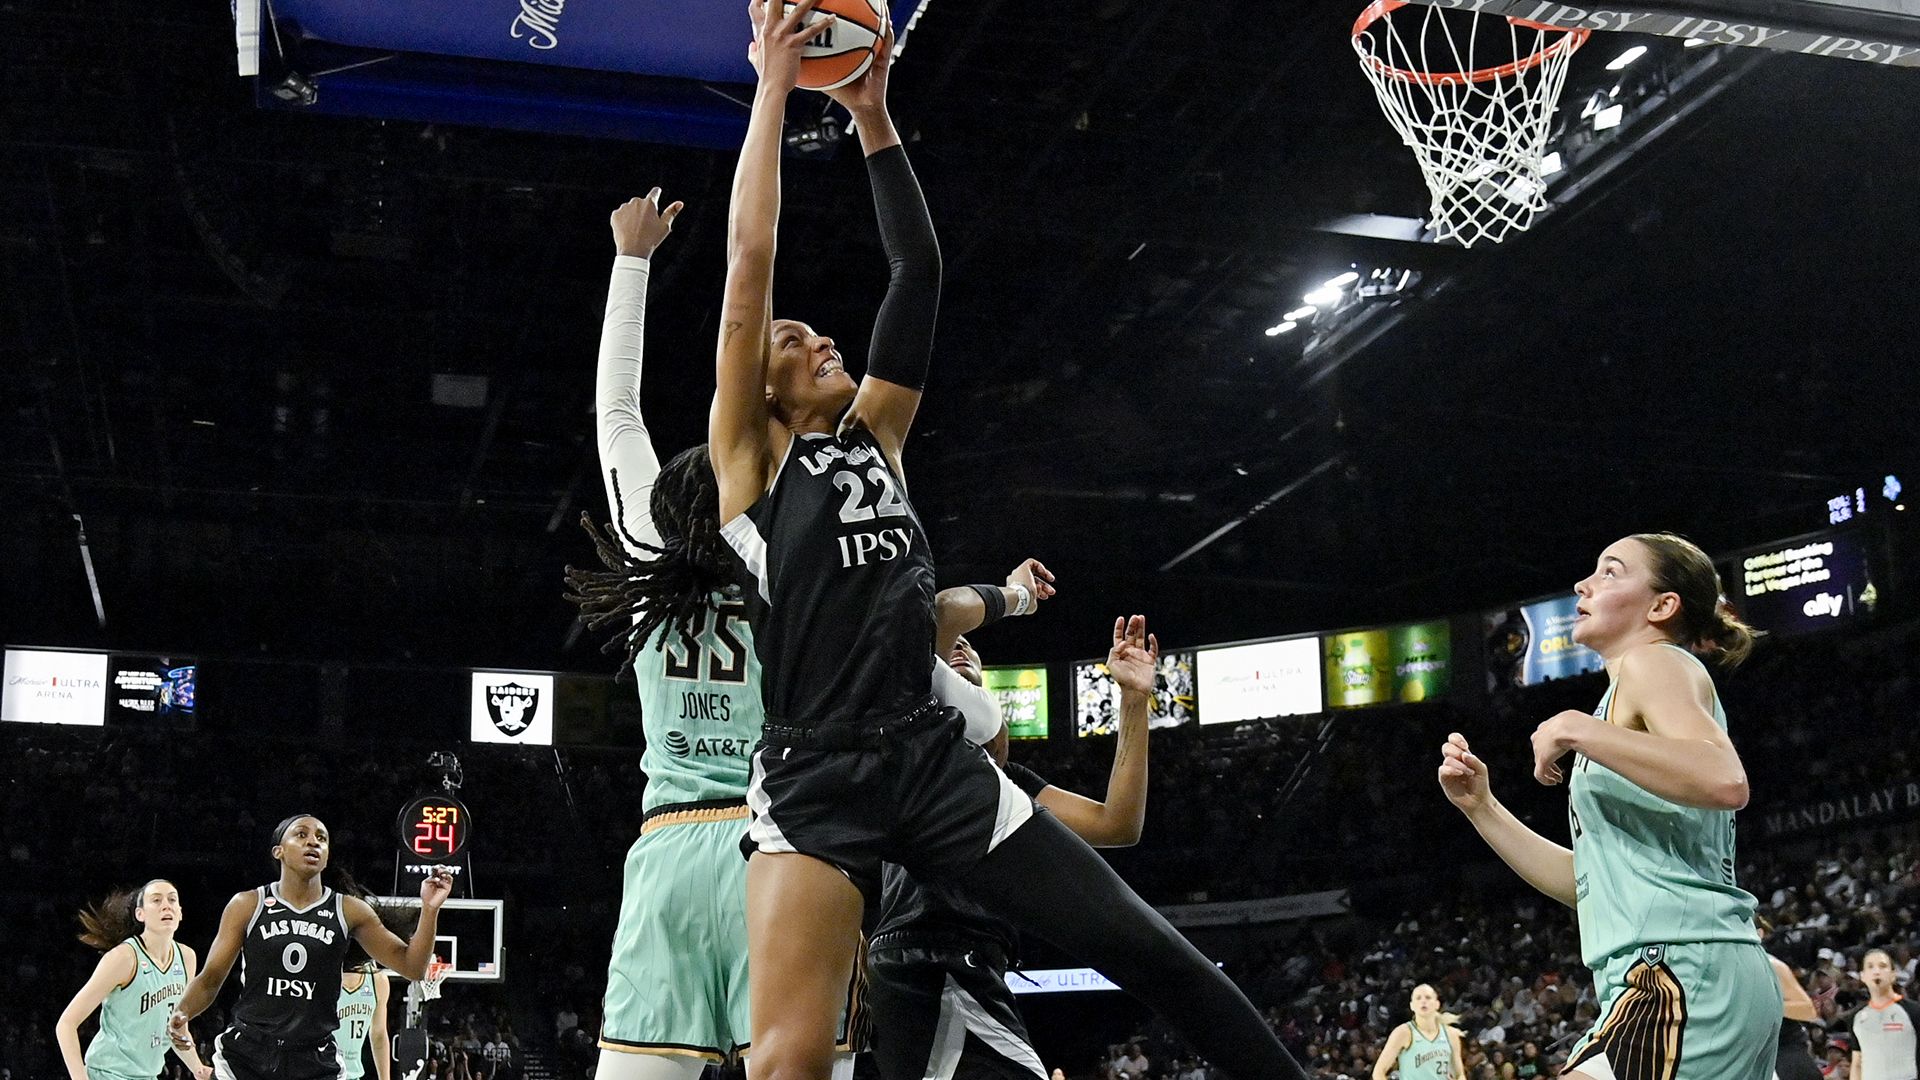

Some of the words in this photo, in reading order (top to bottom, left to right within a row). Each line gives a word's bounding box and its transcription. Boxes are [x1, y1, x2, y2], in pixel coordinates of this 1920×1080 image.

[1525, 0, 1653, 31] IPSY
[1668, 17, 1789, 47] IPSY
[1798, 35, 1920, 64] IPSY
[832, 467, 907, 524] 22
[837, 528, 914, 568] IPSY
[1803, 592, 1843, 617] ally
[60, 678, 100, 689] ULTRA
[1263, 667, 1303, 679] ULTRA
[36, 690, 73, 700] ARENA
[490, 686, 535, 697] RAIDERS
[679, 691, 731, 722] JONES
[695, 738, 749, 757] AT&T
[423, 806, 458, 824] 5:27
[1765, 788, 1896, 835] MANDALAY
[414, 823, 454, 853] 24
[317, 909, 334, 920] ally
[259, 919, 290, 941] LAS
[290, 919, 335, 946] VEGAS
[282, 942, 308, 974] 0
[266, 977, 316, 1000] IPSY
[350, 1019, 365, 1040] 13
